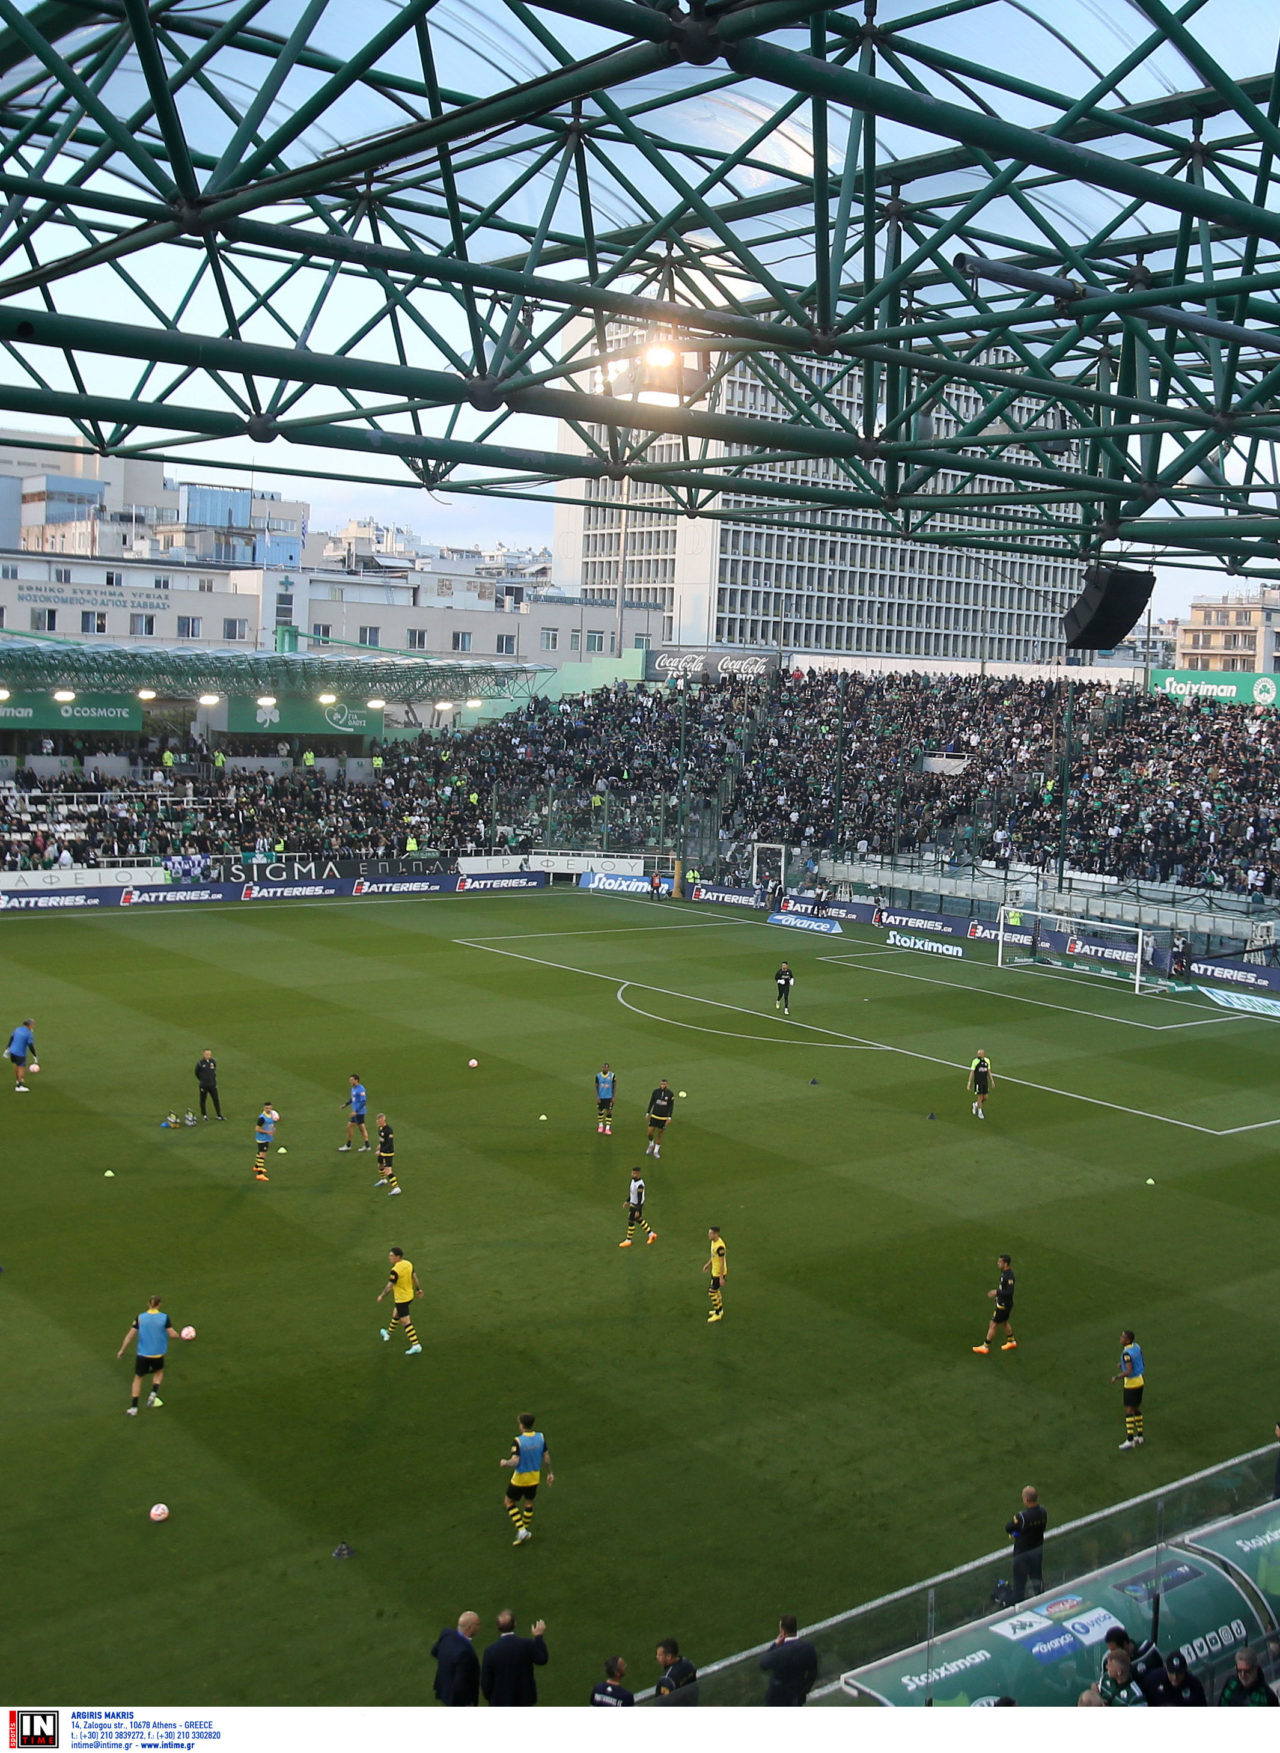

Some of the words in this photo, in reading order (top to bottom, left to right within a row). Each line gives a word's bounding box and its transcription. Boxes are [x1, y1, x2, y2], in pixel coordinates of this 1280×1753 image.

[655, 653, 708, 672] Coca-Cola
[717, 656, 769, 674] Coca-Cola
[1164, 677, 1237, 698] Stoiximan
[73, 706, 130, 718] COSMOTE
[886, 930, 963, 957] Stoiximan
[1190, 962, 1269, 987] ATTERIES.GR
